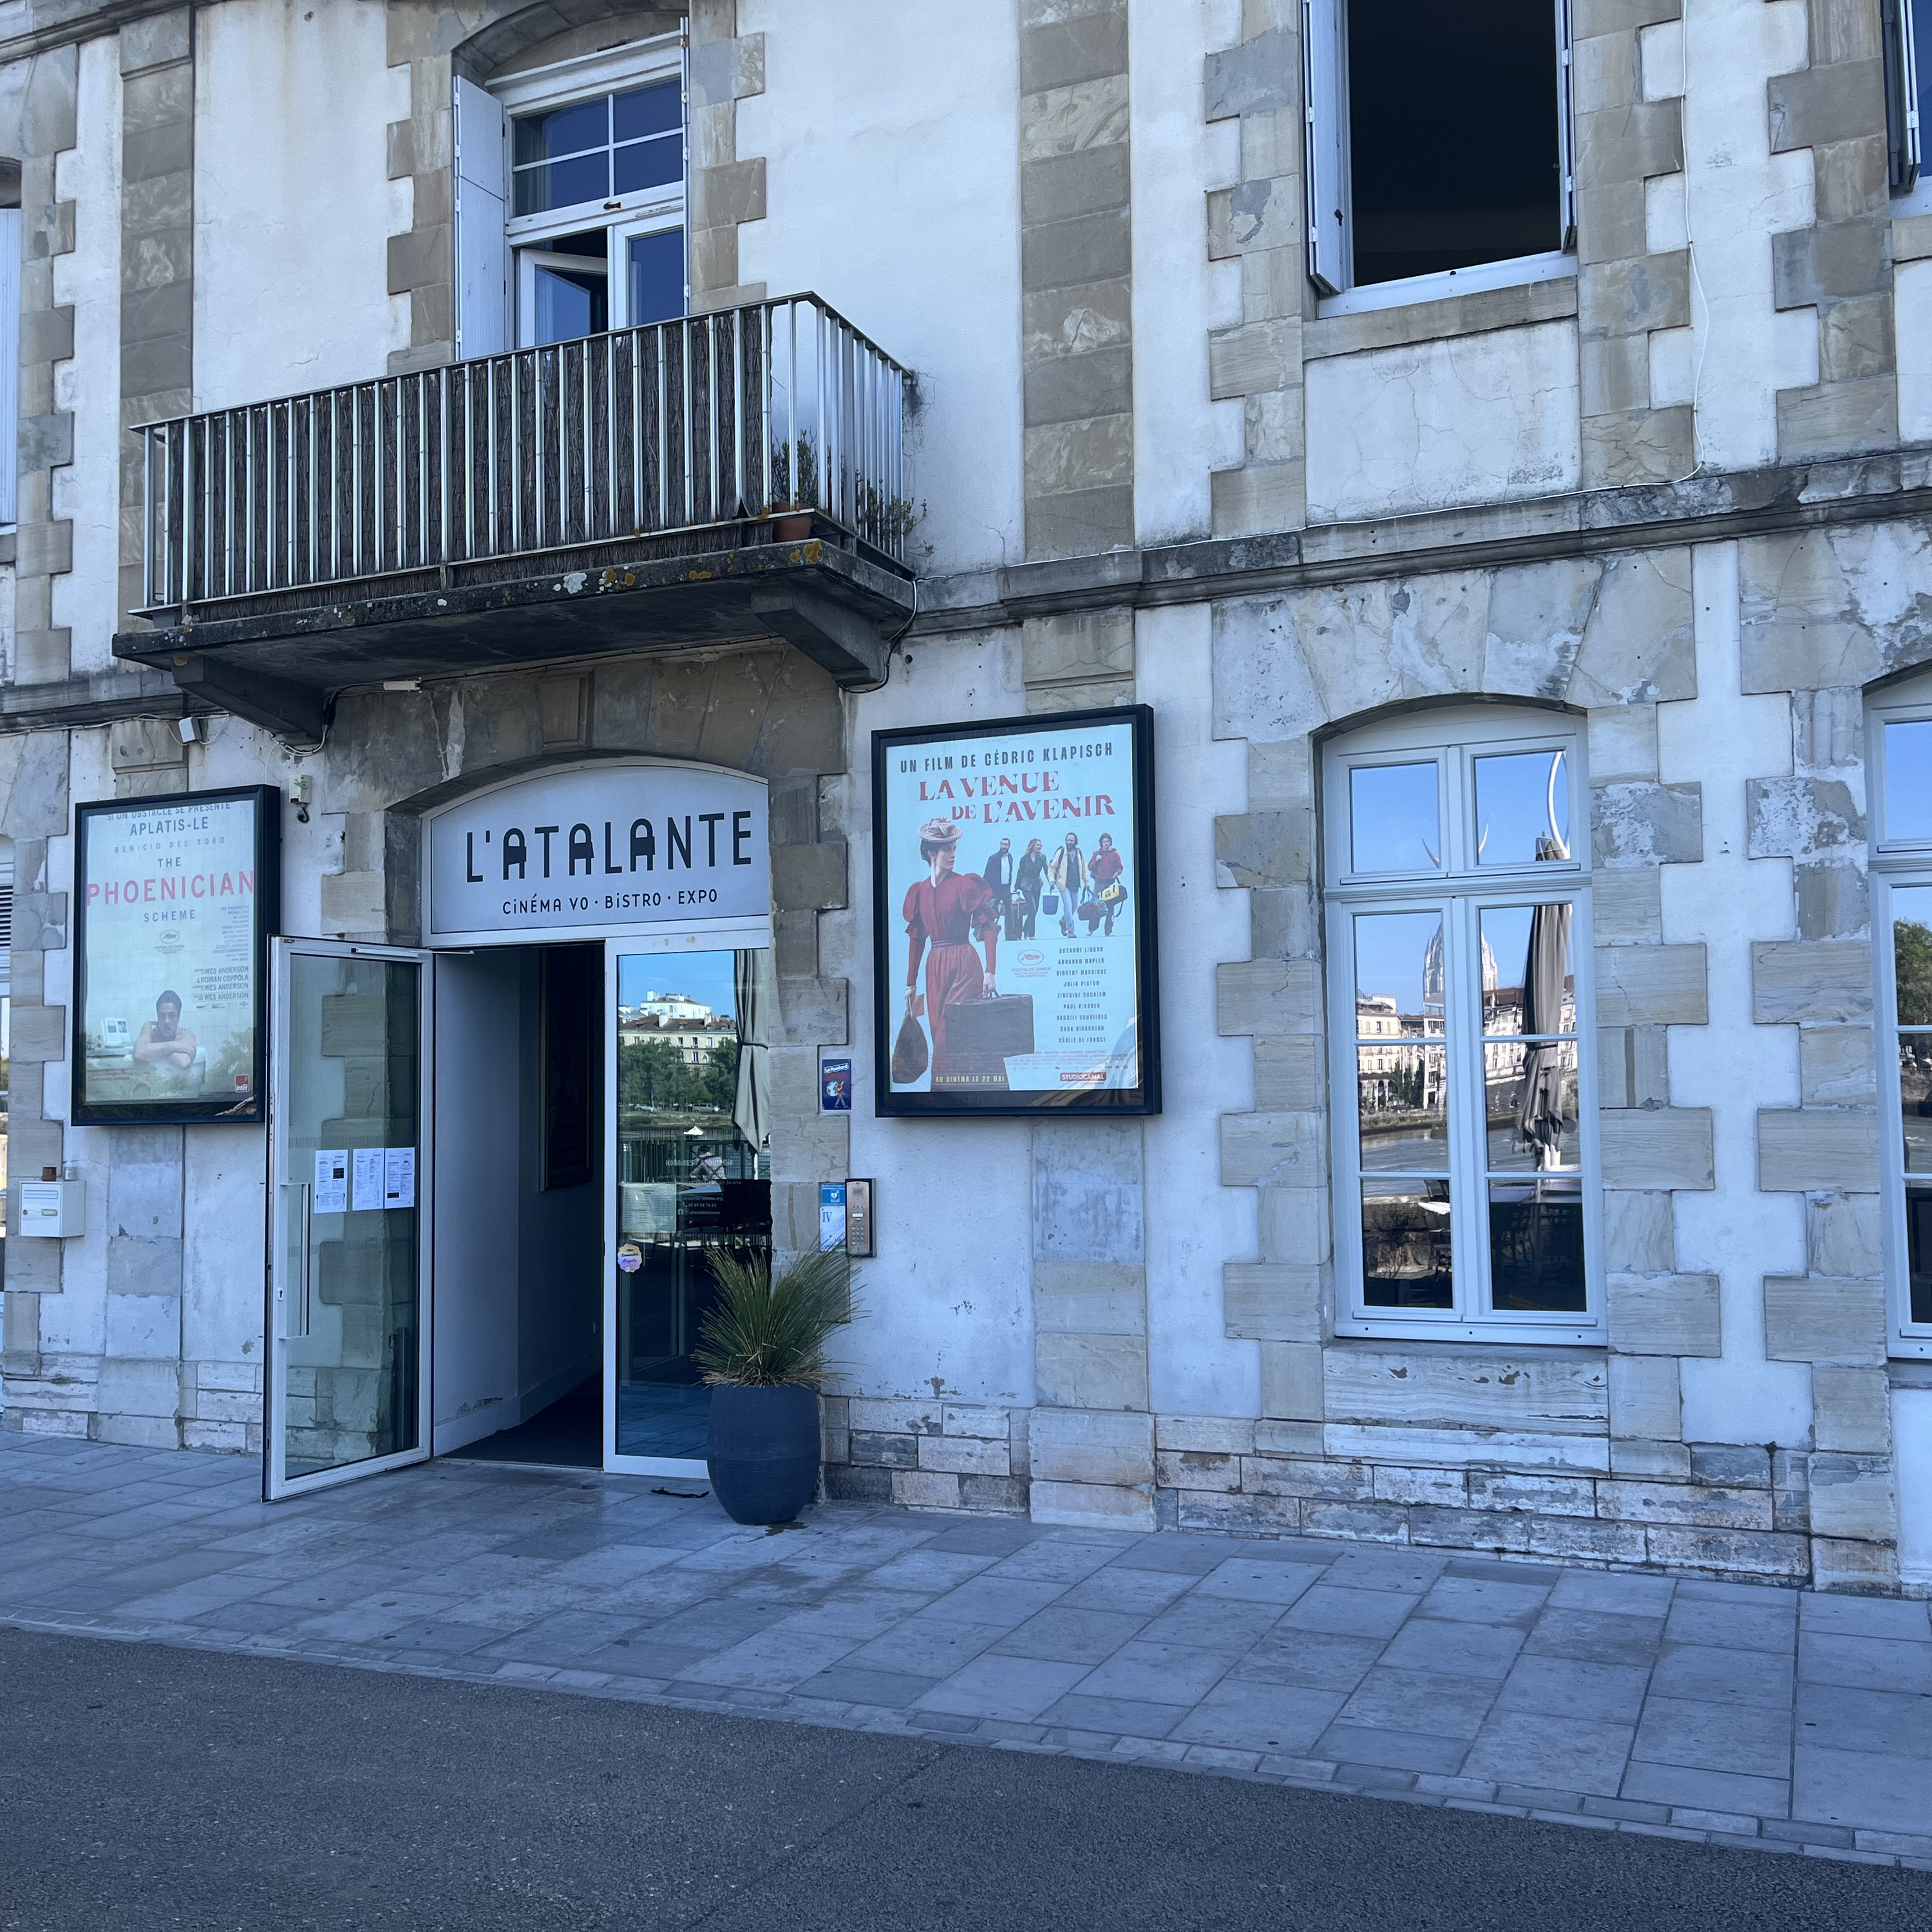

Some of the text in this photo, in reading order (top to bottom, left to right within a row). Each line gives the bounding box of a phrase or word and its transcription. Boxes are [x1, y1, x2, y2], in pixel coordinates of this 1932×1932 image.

[900, 742, 1113, 773] UN FILM DE CÉDRIC KLAPISCH
[919, 770, 1060, 801] LA VENUE
[952, 794, 1115, 824] DE L'AVENIR
[130, 817, 209, 836] APLATIS-LE
[115, 837, 225, 853] BENICIO DEL TORO
[466, 810, 751, 882] L'ATALANTE
[158, 857, 181, 868] THE
[86, 870, 254, 906] PHOENICIAN
[569, 897, 589, 911] VO
[678, 889, 718, 905] EXPO
[144, 909, 195, 922] SCHEME
[218, 982, 249, 990] ANDERSON
[223, 974, 249, 982] COPPOLA
[822, 1212, 832, 1222] IV
